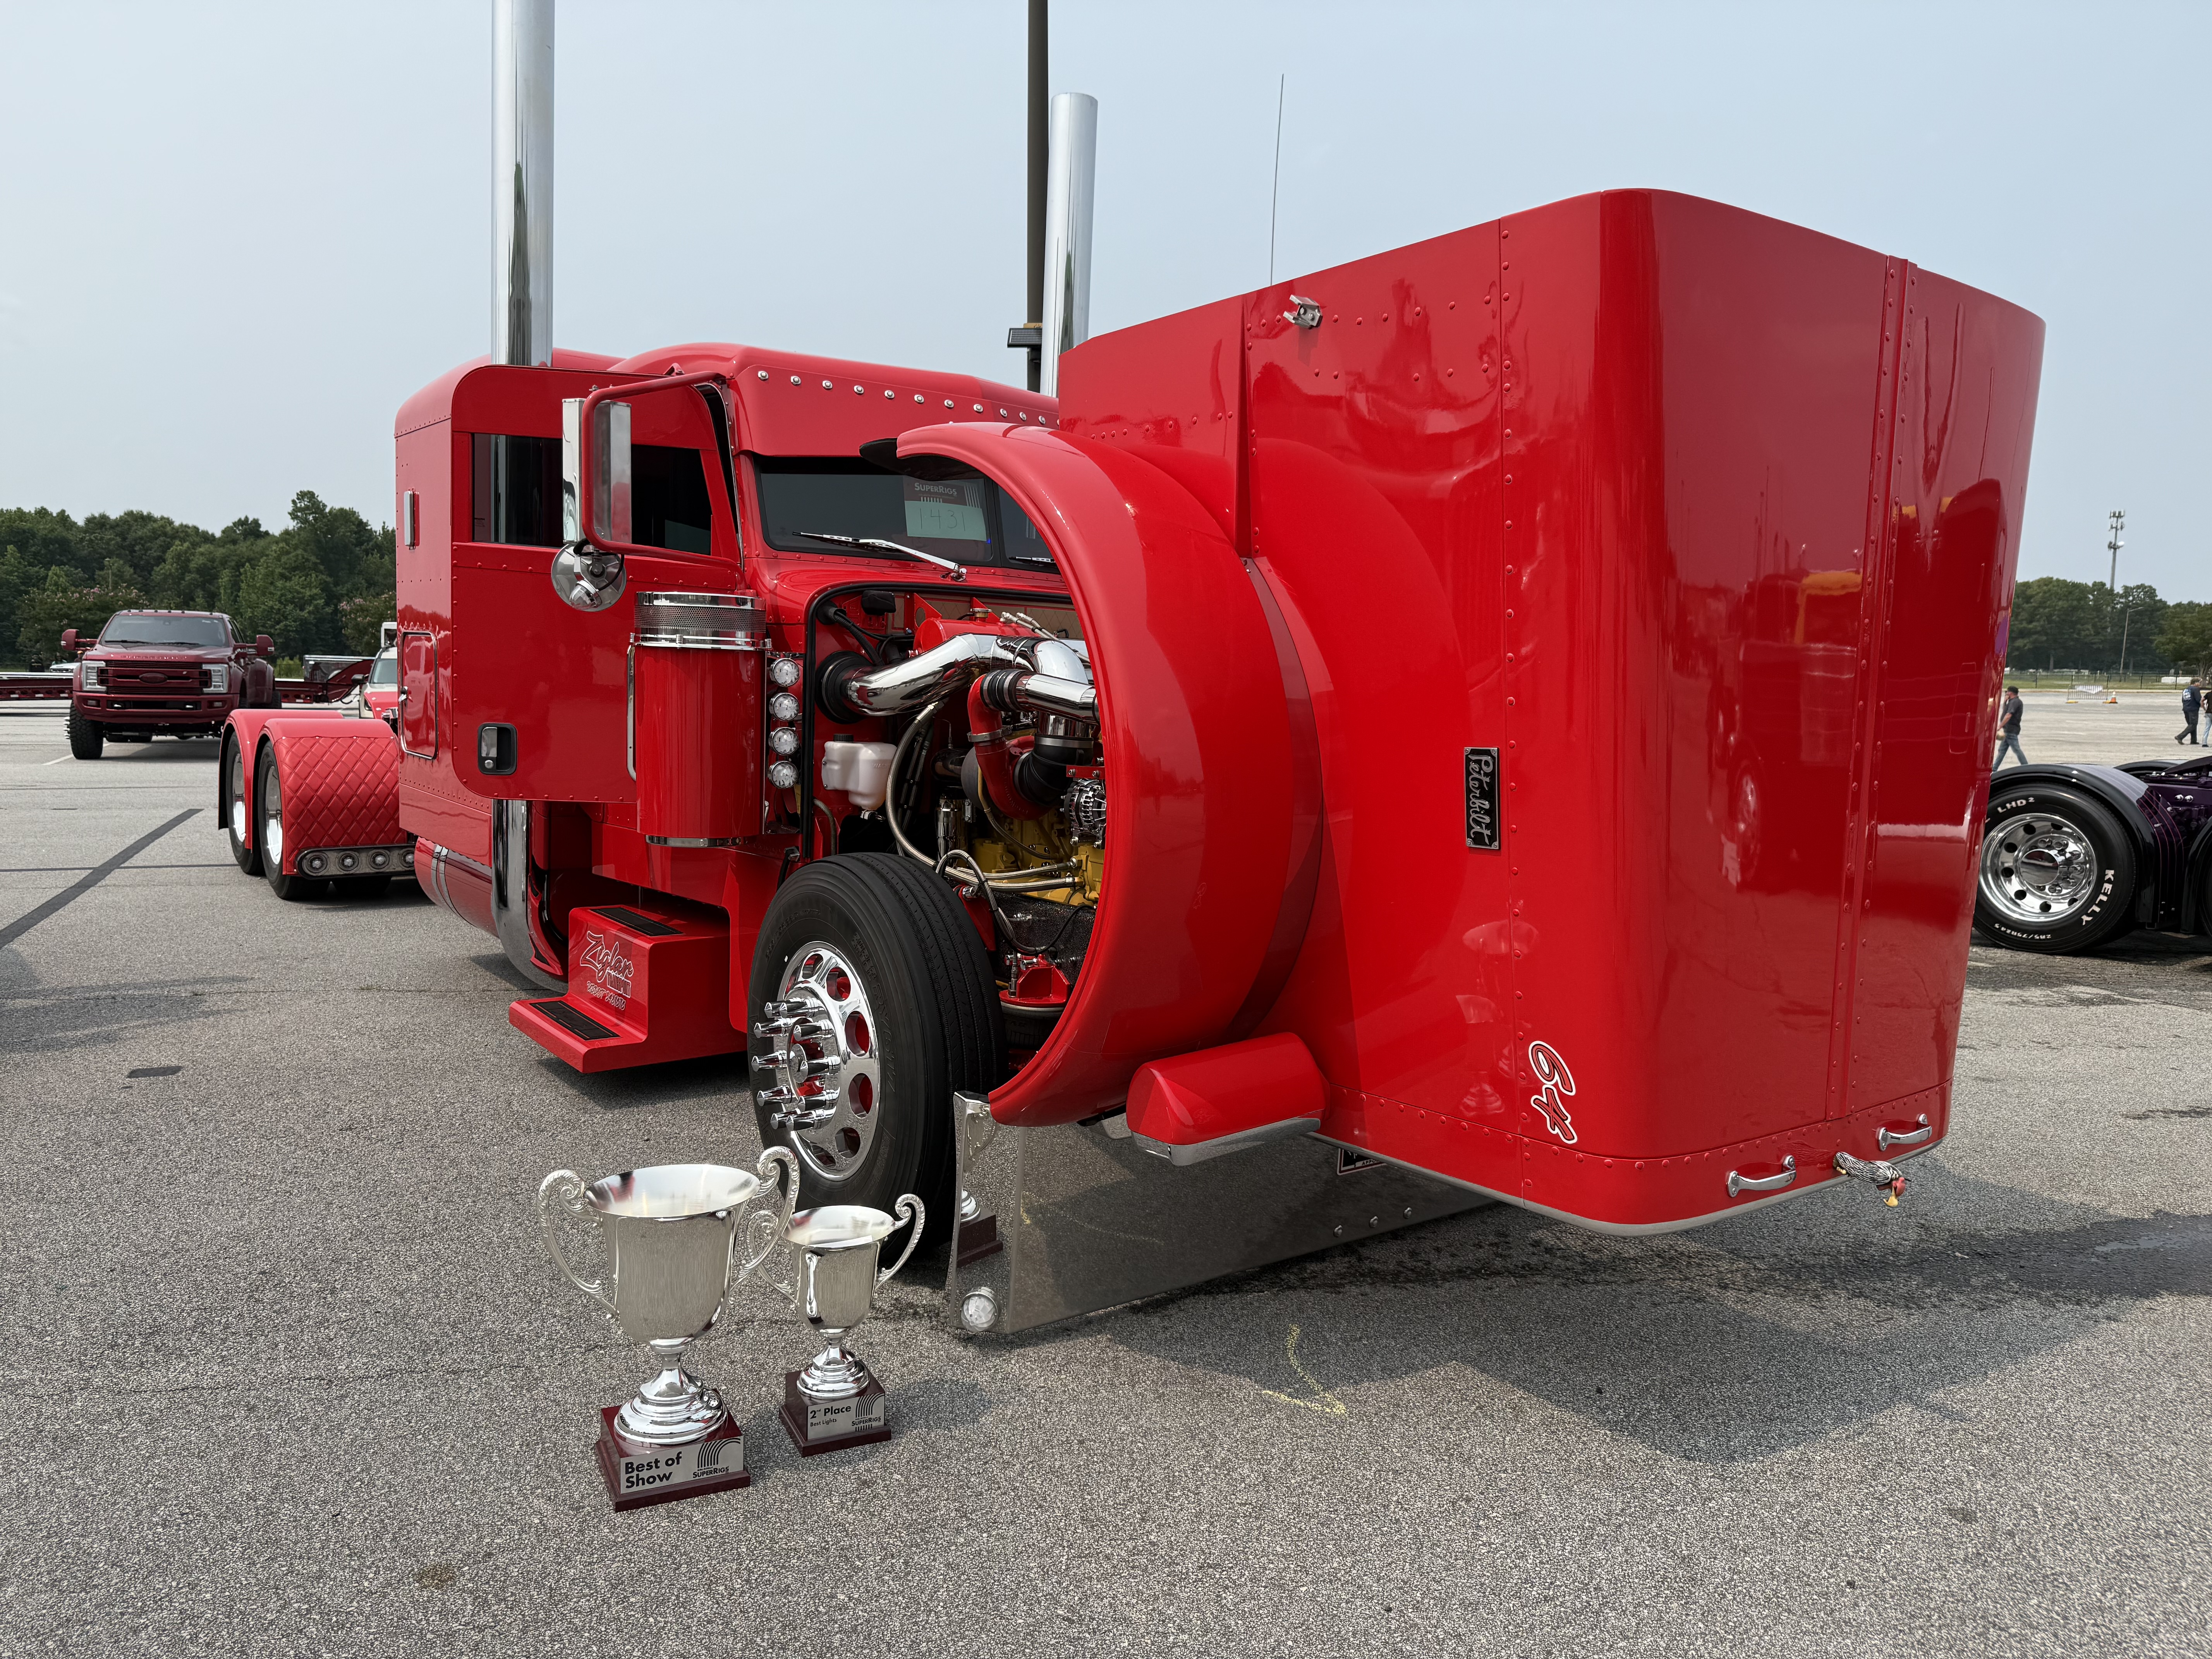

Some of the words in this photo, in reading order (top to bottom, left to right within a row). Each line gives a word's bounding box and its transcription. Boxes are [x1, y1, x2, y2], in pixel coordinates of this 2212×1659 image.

[920, 508, 965, 531] 1431
[1468, 754, 1494, 845] Peterbilt
[2081, 869, 2114, 926] KELLY
[1528, 1041, 1578, 1144] 64
[824, 1406, 852, 1417] Place
[625, 1458, 660, 1475] Best
[665, 1451, 682, 1467] of
[625, 1472, 673, 1489] Show
